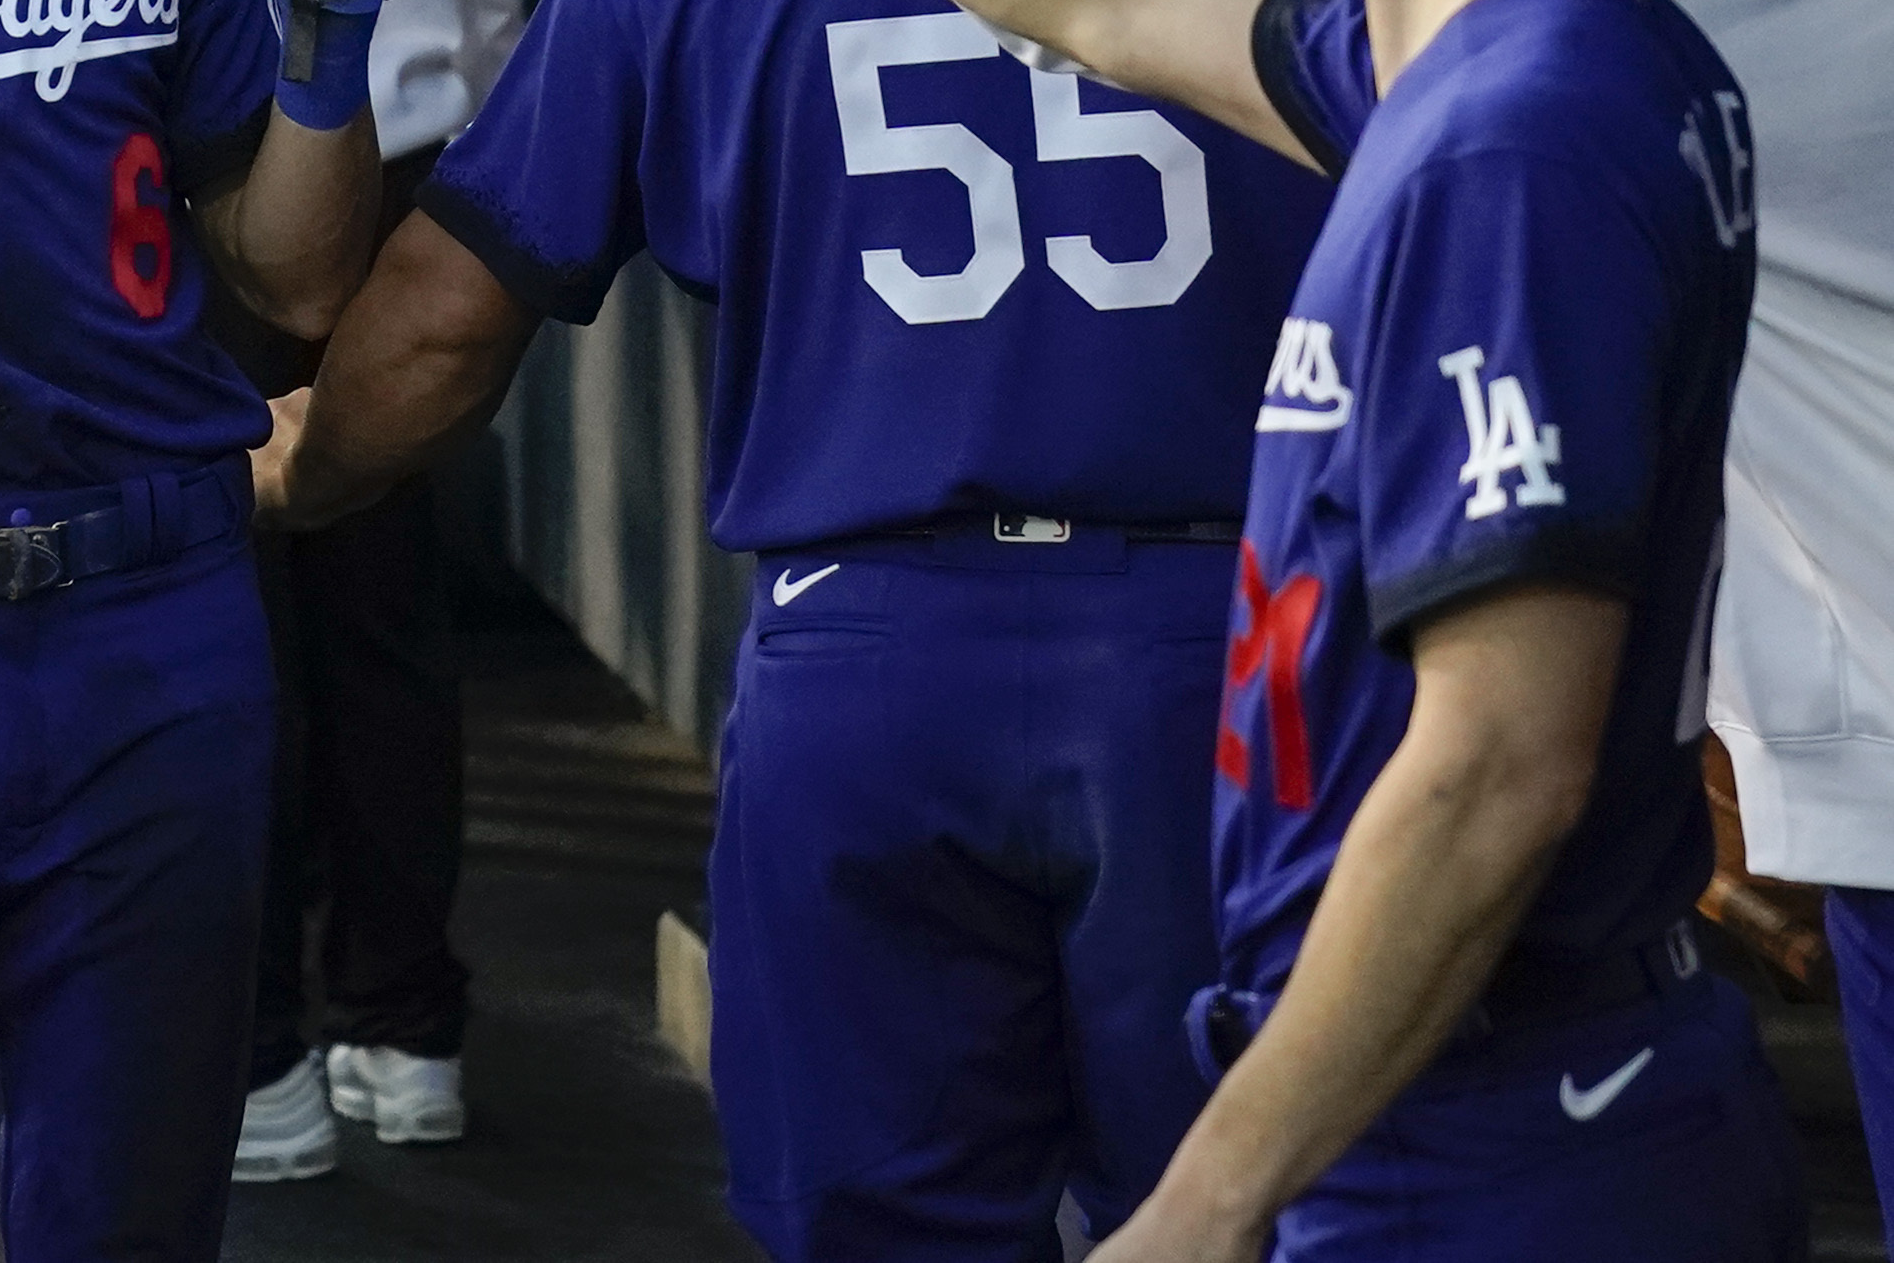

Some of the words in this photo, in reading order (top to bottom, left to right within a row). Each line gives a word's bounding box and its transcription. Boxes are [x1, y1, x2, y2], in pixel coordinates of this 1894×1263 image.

[111, 132, 172, 319] 6
[825, 9, 1213, 325] 55
[1438, 345, 1566, 520] LA
